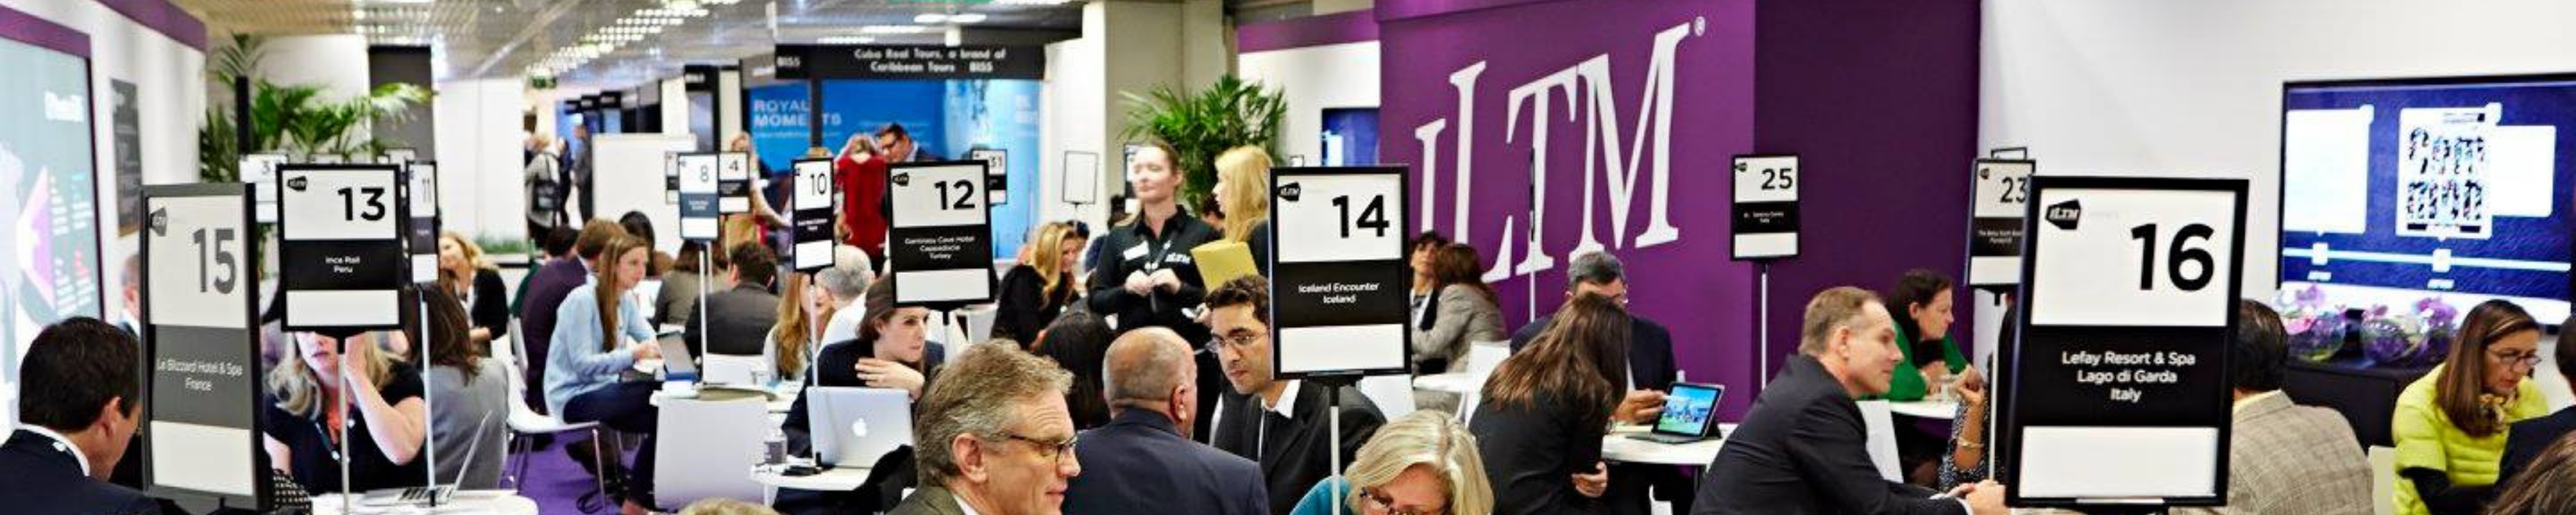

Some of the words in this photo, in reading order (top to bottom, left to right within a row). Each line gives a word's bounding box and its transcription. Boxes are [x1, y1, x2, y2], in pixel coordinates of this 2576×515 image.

[854, 49, 882, 59] Cuba
[885, 49, 910, 59] Real
[960, 49, 990, 59] brand
[994, 48, 1006, 59] of
[870, 61, 924, 72] Caribbean
[928, 61, 955, 72] Tours
[753, 100, 809, 112] ROYAL
[753, 112, 842, 126] MOMETS
[700, 165, 709, 183] 8
[1761, 168, 1793, 191] 25
[809, 172, 827, 196] 10
[2000, 176, 2027, 203] 23
[934, 179, 975, 211] 12
[338, 187, 385, 221] 13
[1332, 194, 1390, 239] 14
[192, 228, 237, 295] 15
[2131, 223, 2215, 292] 16
[1298, 283, 1332, 293] Iceland
[1333, 282, 1379, 292] Encounter
[1323, 295, 1356, 304] Iceland
[2062, 351, 2102, 366] Lefay
[2104, 351, 2151, 365] Resort
[2153, 351, 2165, 365] &
[2168, 351, 2196, 366] Spa
[157, 358, 166, 371] Le
[167, 358, 197, 373] Blizzard
[198, 361, 218, 374] Hotel
[219, 361, 226, 375] &
[227, 363, 243, 377] Spa
[185, 377, 212, 391] France
[2077, 370, 2114, 385] Lago
[2116, 370, 2131, 382] di
[2134, 369, 2178, 383] Garda
[2110, 388, 2142, 403] Italy
